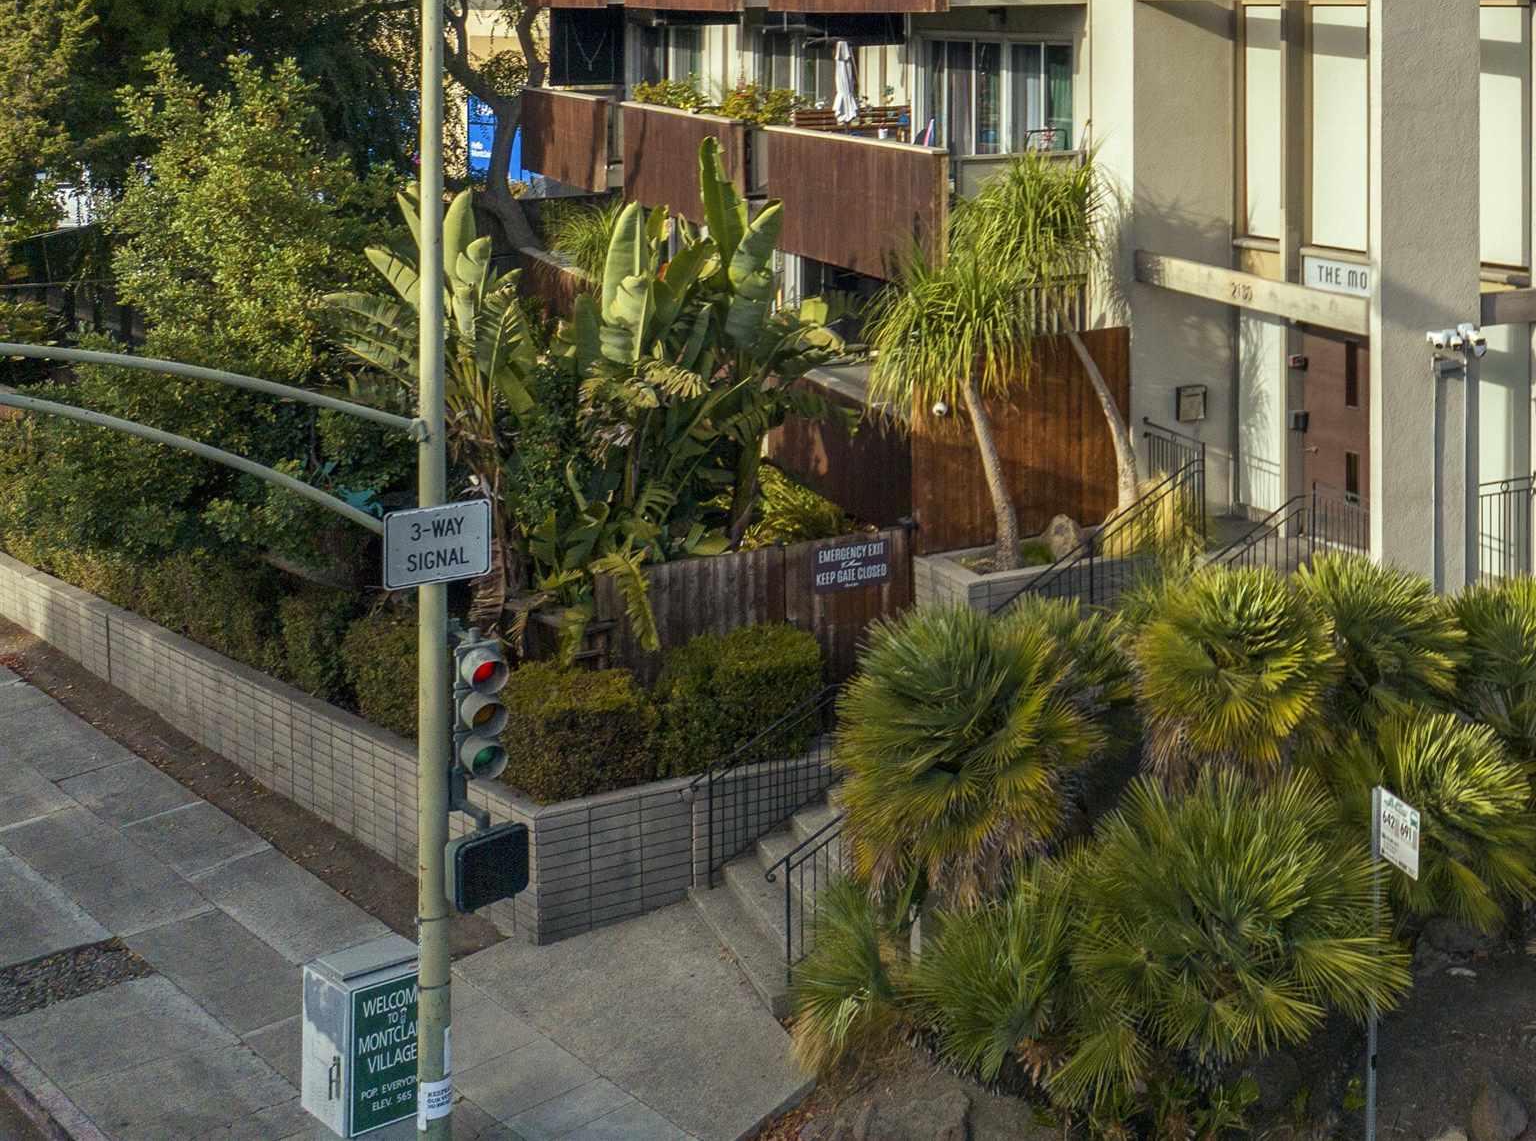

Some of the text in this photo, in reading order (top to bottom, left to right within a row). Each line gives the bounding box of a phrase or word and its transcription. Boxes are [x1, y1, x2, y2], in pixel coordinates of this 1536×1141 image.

[1317, 265, 1343, 285] THE
[410, 516, 464, 541] 3-WAY
[407, 547, 469, 572] SIGNAL
[818, 545, 867, 564] EMERGENCY
[868, 542, 884, 557] EXIT
[816, 572, 836, 586] KEEP
[837, 568, 856, 583] GATE
[857, 563, 887, 579] CLOSED
[363, 985, 417, 1018] WELCOM
[388, 1013, 399, 1025] TO
[367, 1043, 417, 1074] VILLAGE
[382, 1076, 417, 1094] EVERYON
[397, 1090, 412, 1104] 565
